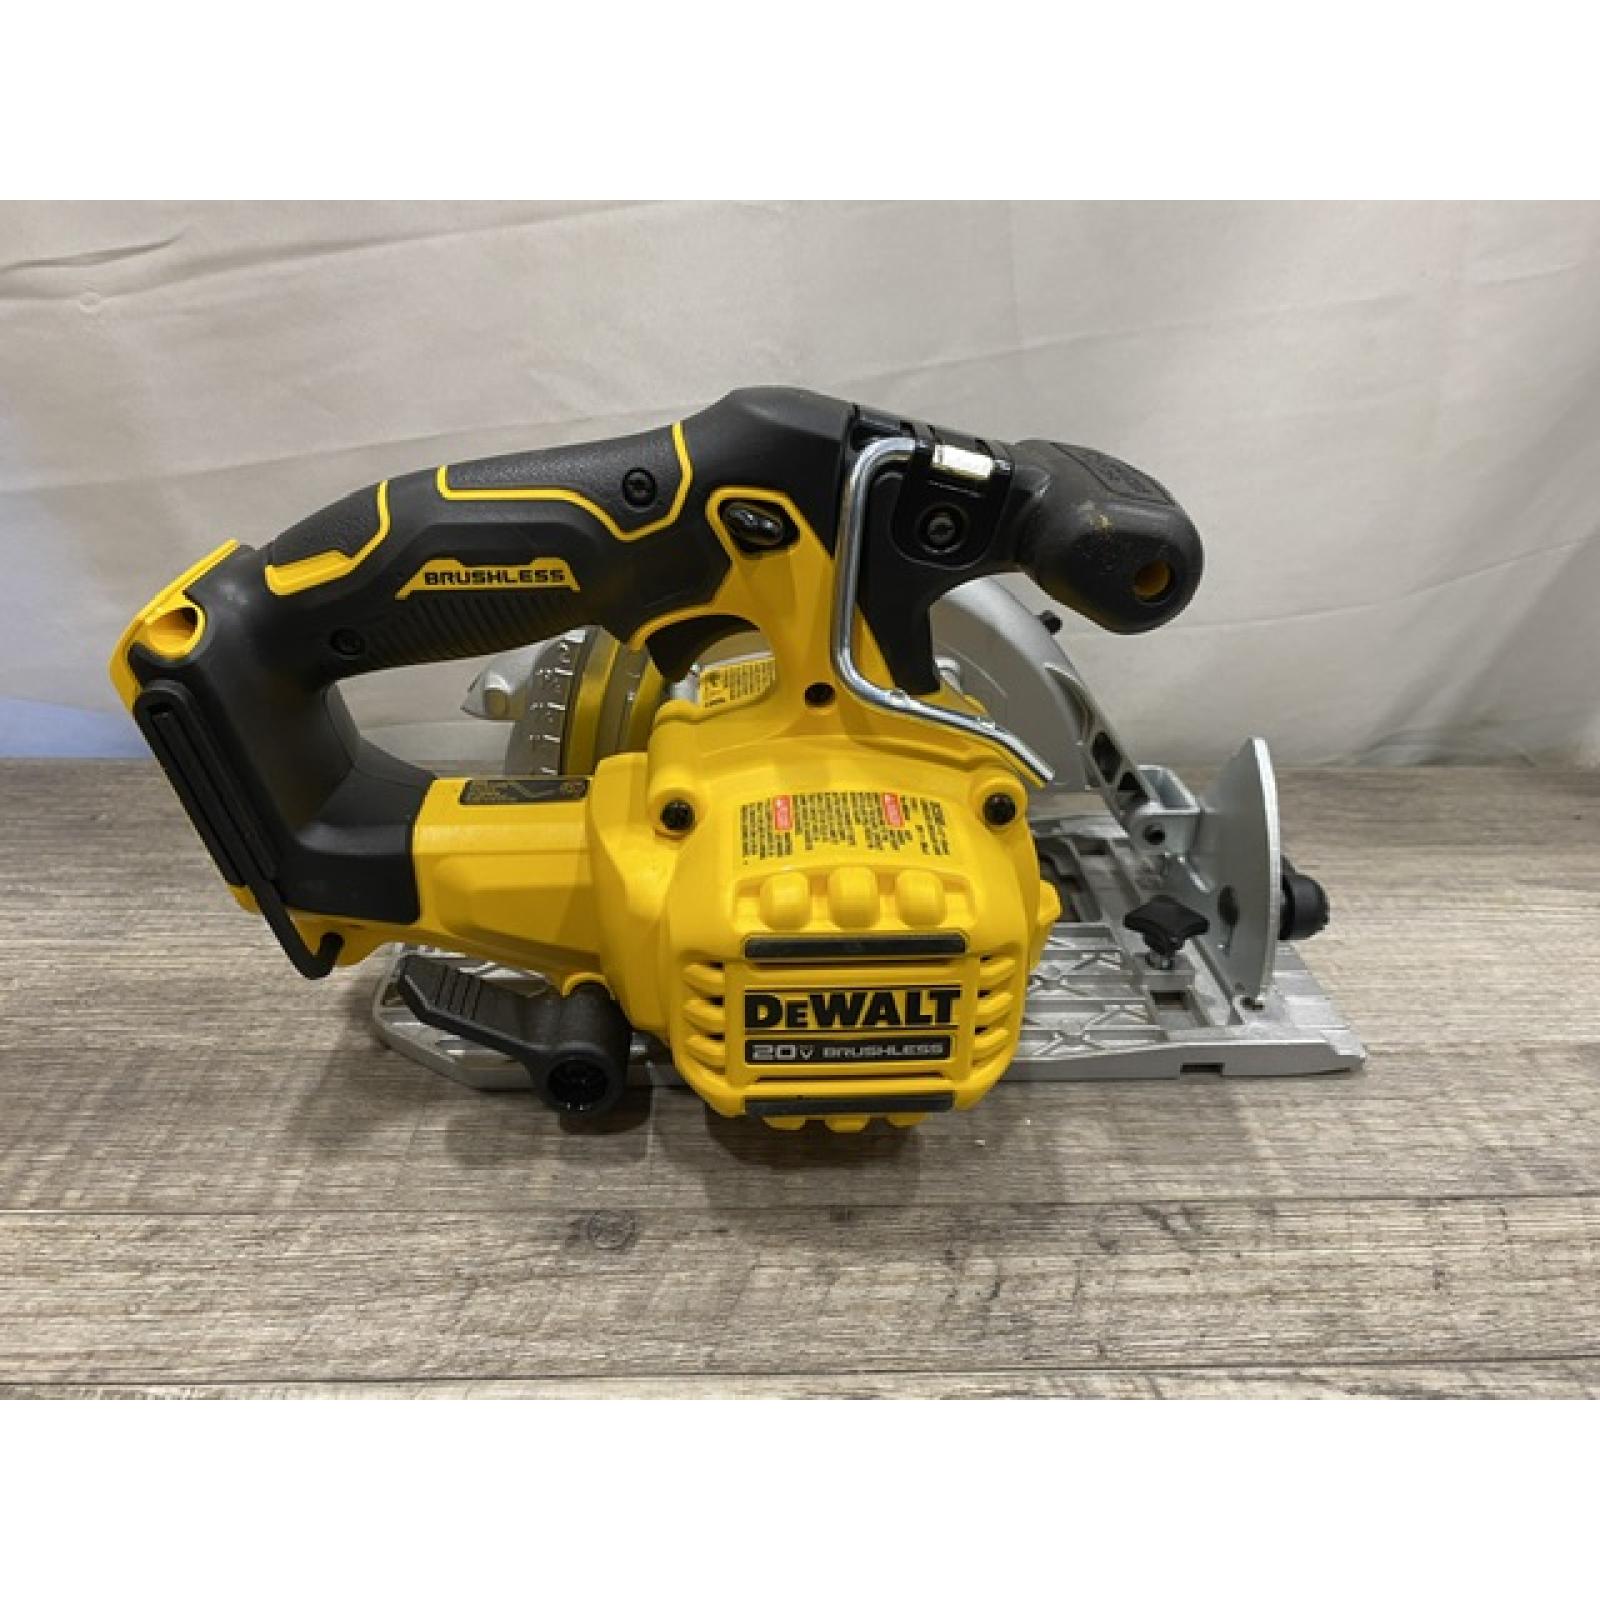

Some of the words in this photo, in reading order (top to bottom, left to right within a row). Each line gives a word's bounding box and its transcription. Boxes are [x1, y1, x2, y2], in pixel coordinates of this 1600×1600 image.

[425, 570, 566, 585] BRUSHLESS
[745, 990, 960, 1028] DEWALT
[822, 1043, 943, 1058] BRUSHLESS
